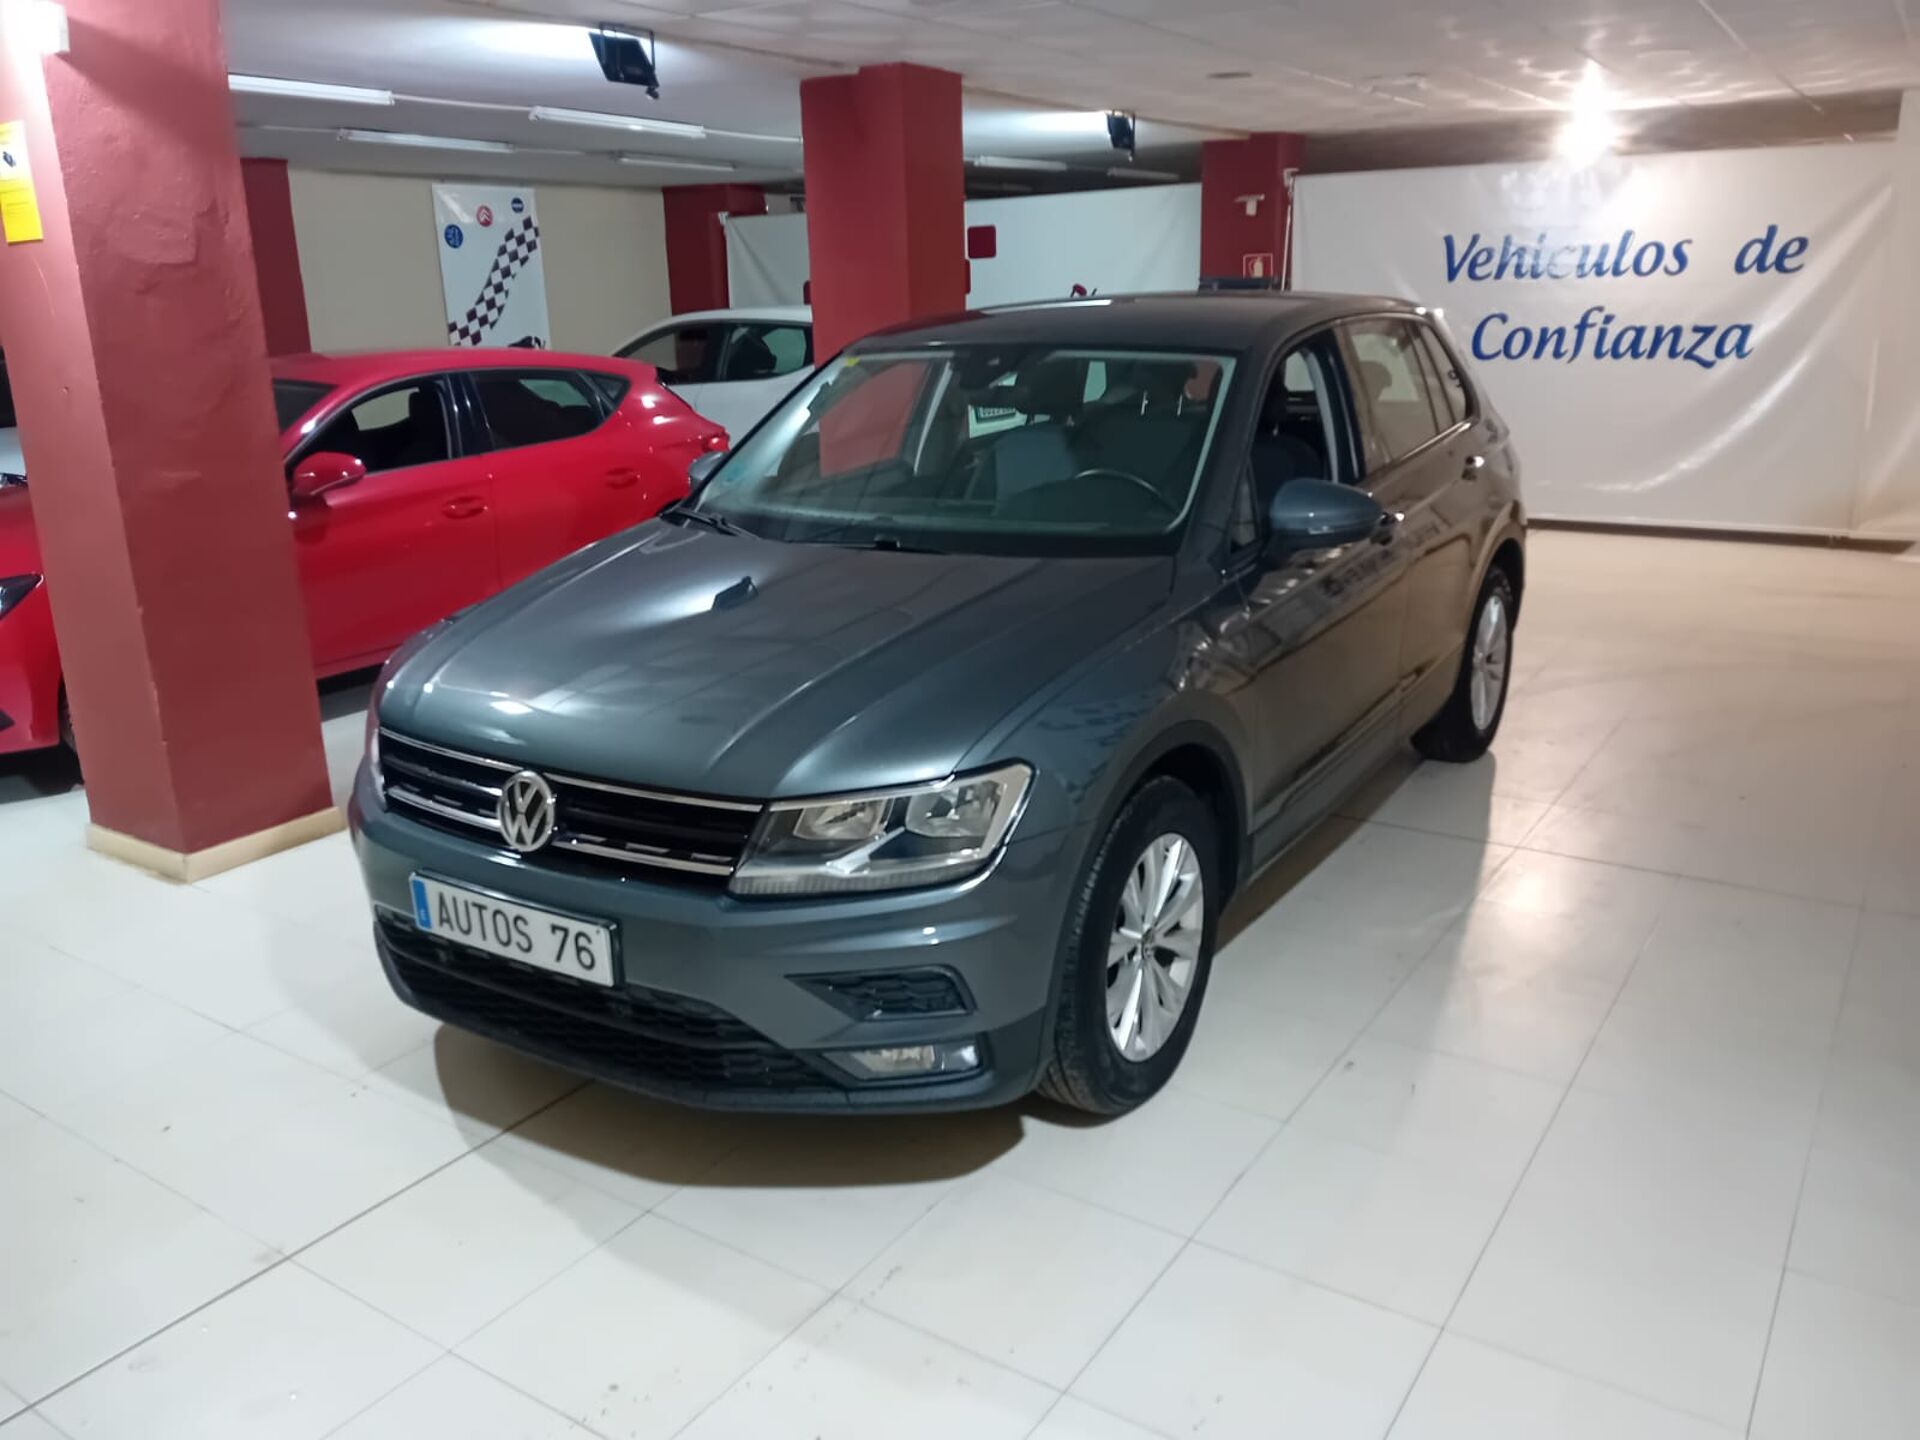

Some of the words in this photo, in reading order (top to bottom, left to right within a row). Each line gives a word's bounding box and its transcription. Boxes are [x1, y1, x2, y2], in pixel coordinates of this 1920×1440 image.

[1734, 224, 1810, 275] de
[1471, 306, 1755, 369] Confianza
[438, 892, 533, 953] AUTOS
[550, 924, 596, 971] 76
